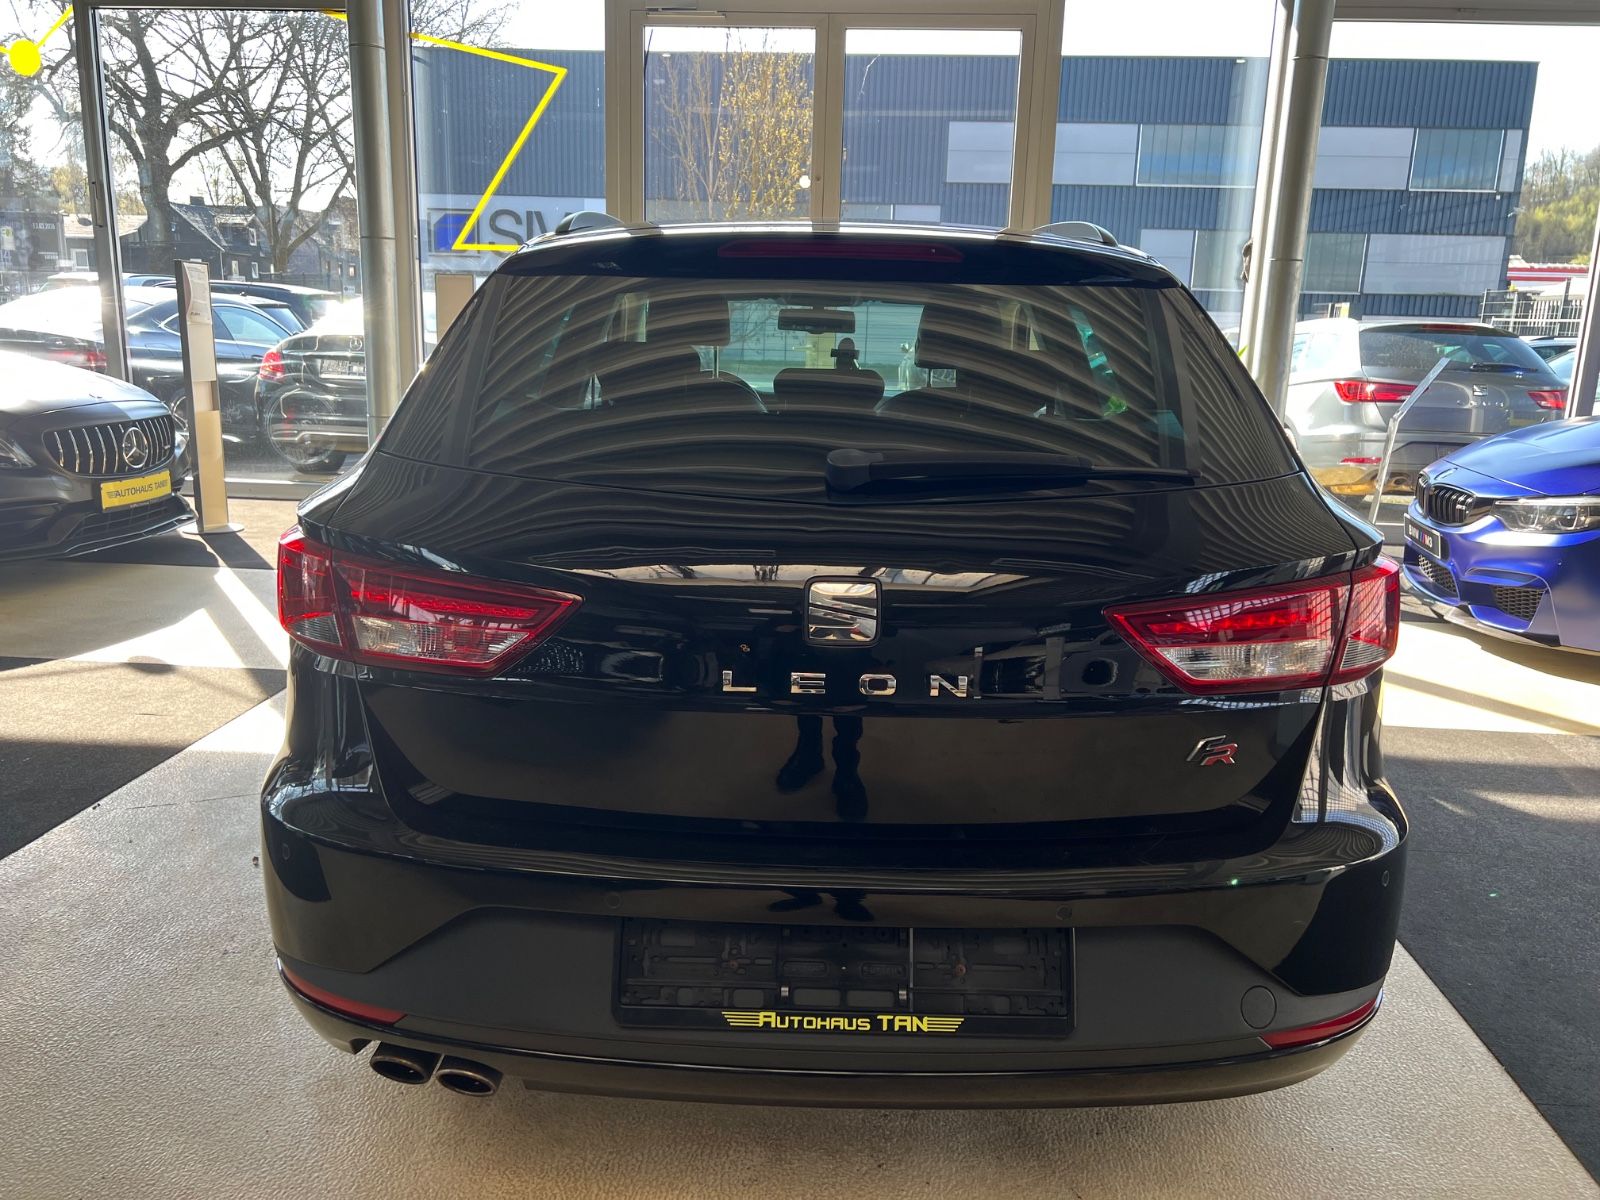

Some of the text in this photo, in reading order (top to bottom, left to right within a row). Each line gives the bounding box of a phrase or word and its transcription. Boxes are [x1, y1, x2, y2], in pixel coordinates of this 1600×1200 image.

[114, 484, 154, 498] AUTOHAUS
[722, 670, 968, 698] LEON
[1186, 734, 1238, 766] FR
[759, 1011, 929, 1032] AUTOHAUS TAN
